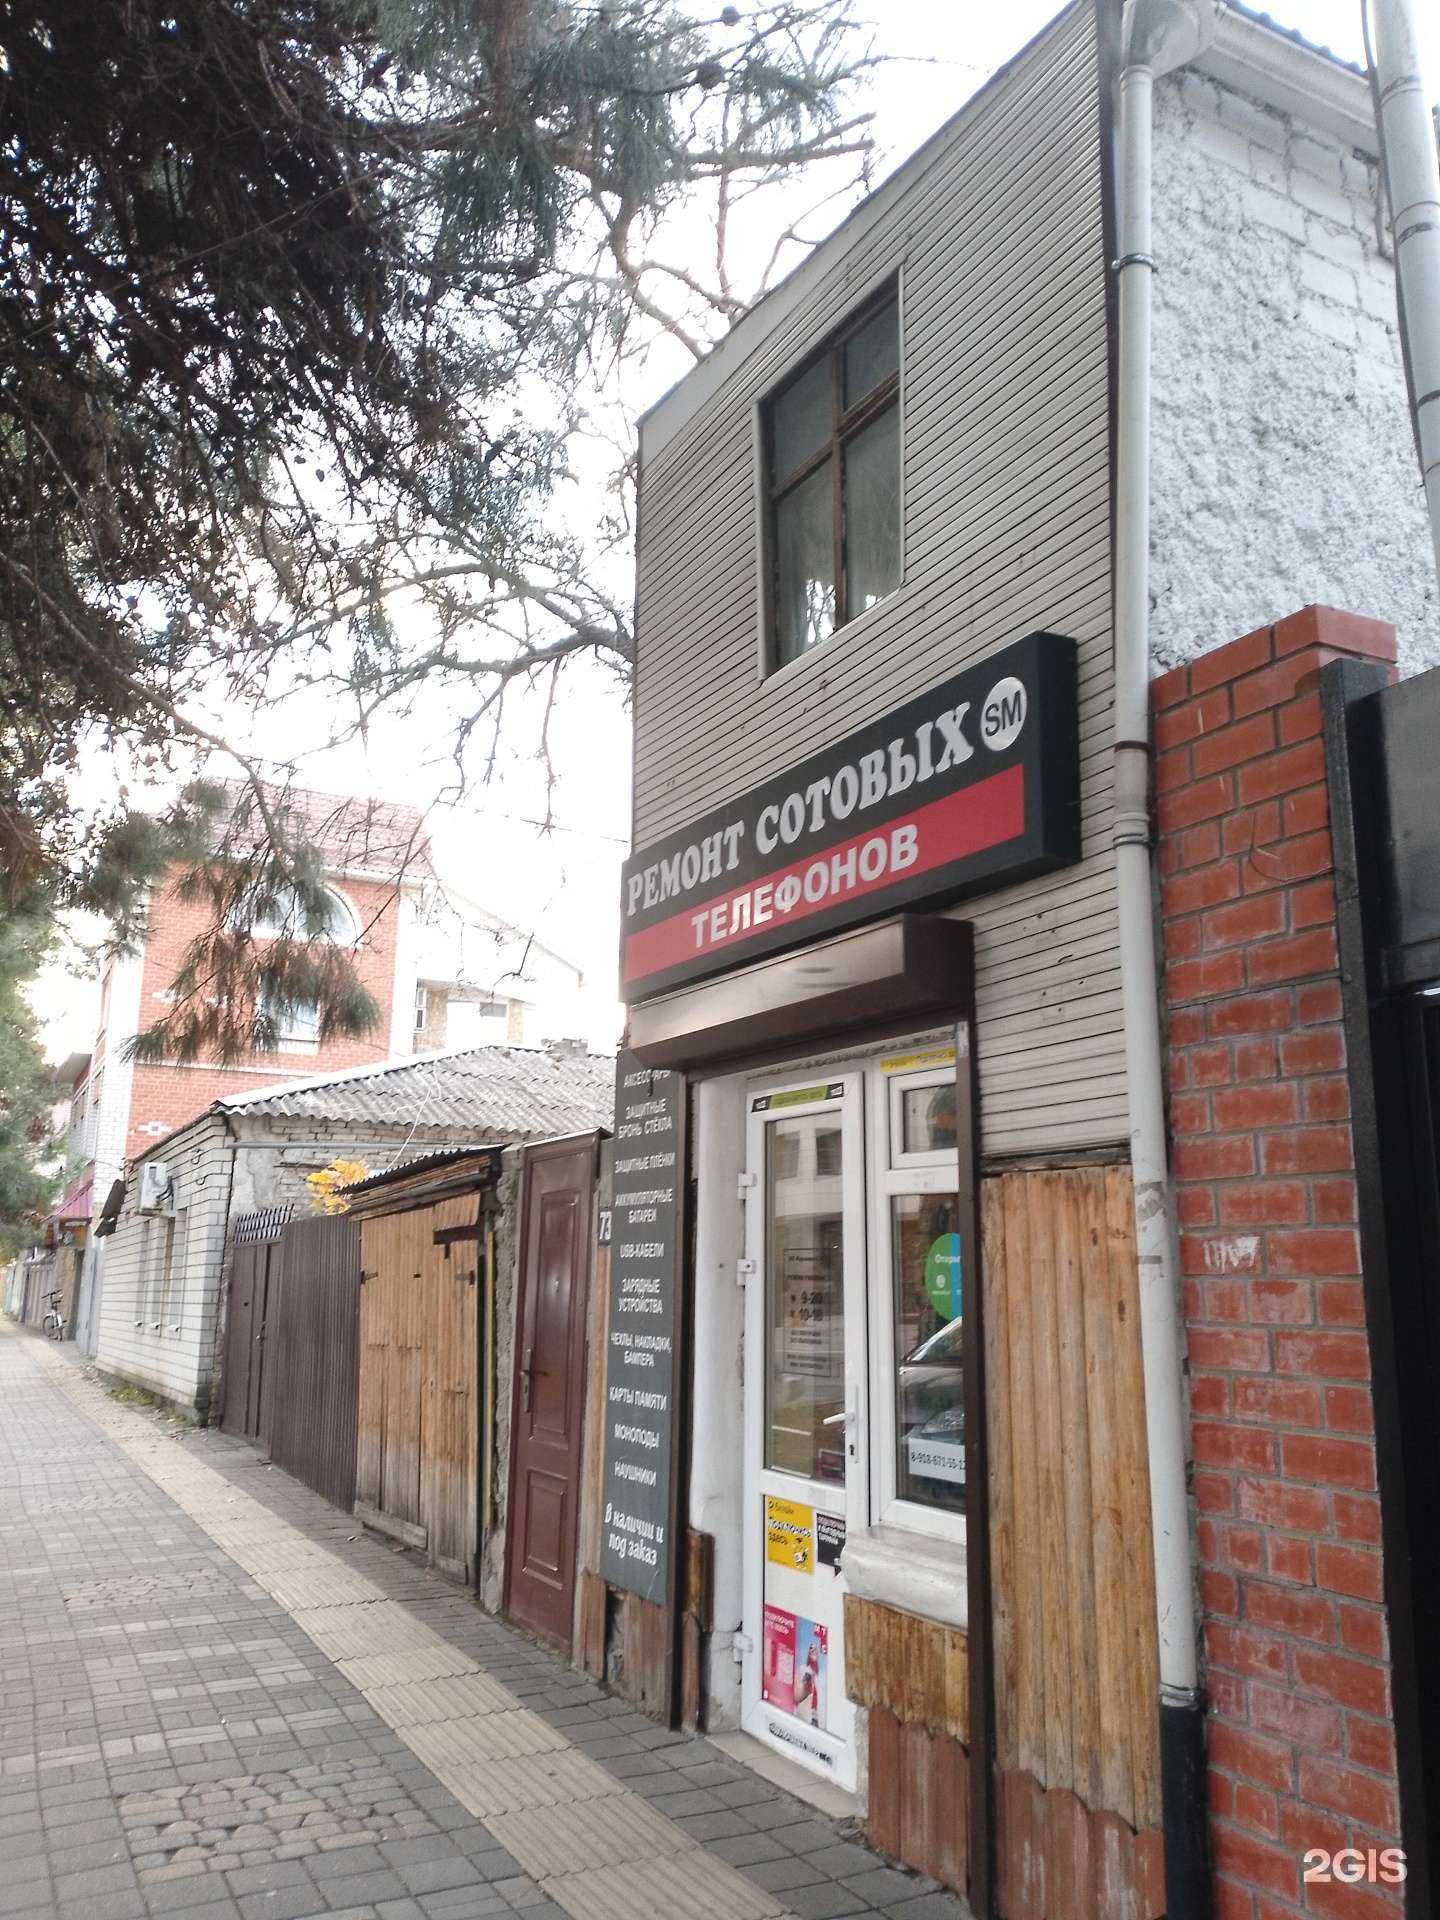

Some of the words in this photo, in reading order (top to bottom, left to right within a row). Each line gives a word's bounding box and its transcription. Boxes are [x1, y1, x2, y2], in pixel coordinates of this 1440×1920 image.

[985, 689, 1022, 738] SM
[626, 820, 745, 916] РЕМОНТ
[755, 701, 974, 856] СОТОВЫХ
[691, 824, 919, 948] ТЕЛЕФОНОВ
[621, 1278, 660, 1295] ЗАРЯДНЫЕ
[610, 1386, 634, 1404] КАРТЫ
[635, 1391, 667, 1411] ПАМЯТИ
[614, 1424, 659, 1449] МОНОПОДЫ
[614, 1461, 656, 1487] НАУШНИКИ
[613, 1508, 653, 1539] наличии
[608, 1533, 626, 1559] под
[627, 1539, 658, 1566] заказ
